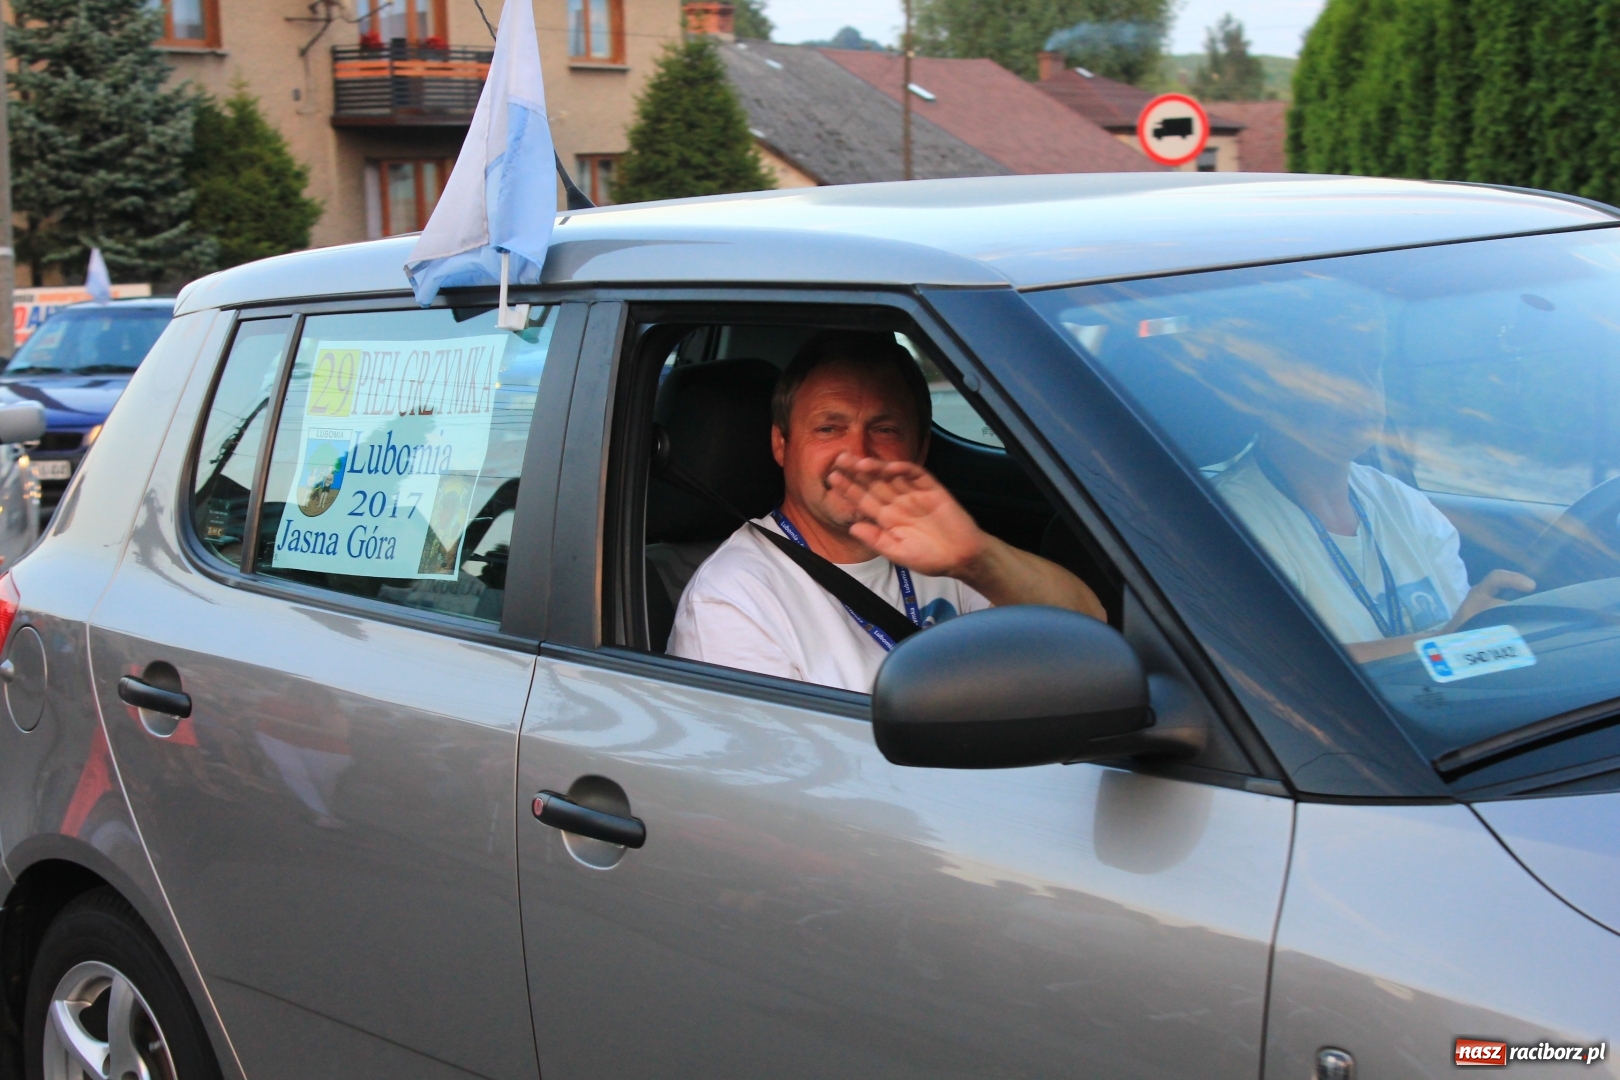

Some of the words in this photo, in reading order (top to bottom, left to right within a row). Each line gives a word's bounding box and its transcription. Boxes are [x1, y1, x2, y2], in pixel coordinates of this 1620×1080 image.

[308, 352, 355, 416] 29
[350, 344, 495, 417] PIELGRZYMKA
[316, 429, 344, 439] LUBOMIA
[347, 430, 453, 476] Lubomia
[347, 490, 423, 519] 2017
[277, 519, 339, 556] Jasna
[346, 525, 396, 560] Góra
[780, 520, 799, 541] Lubomia
